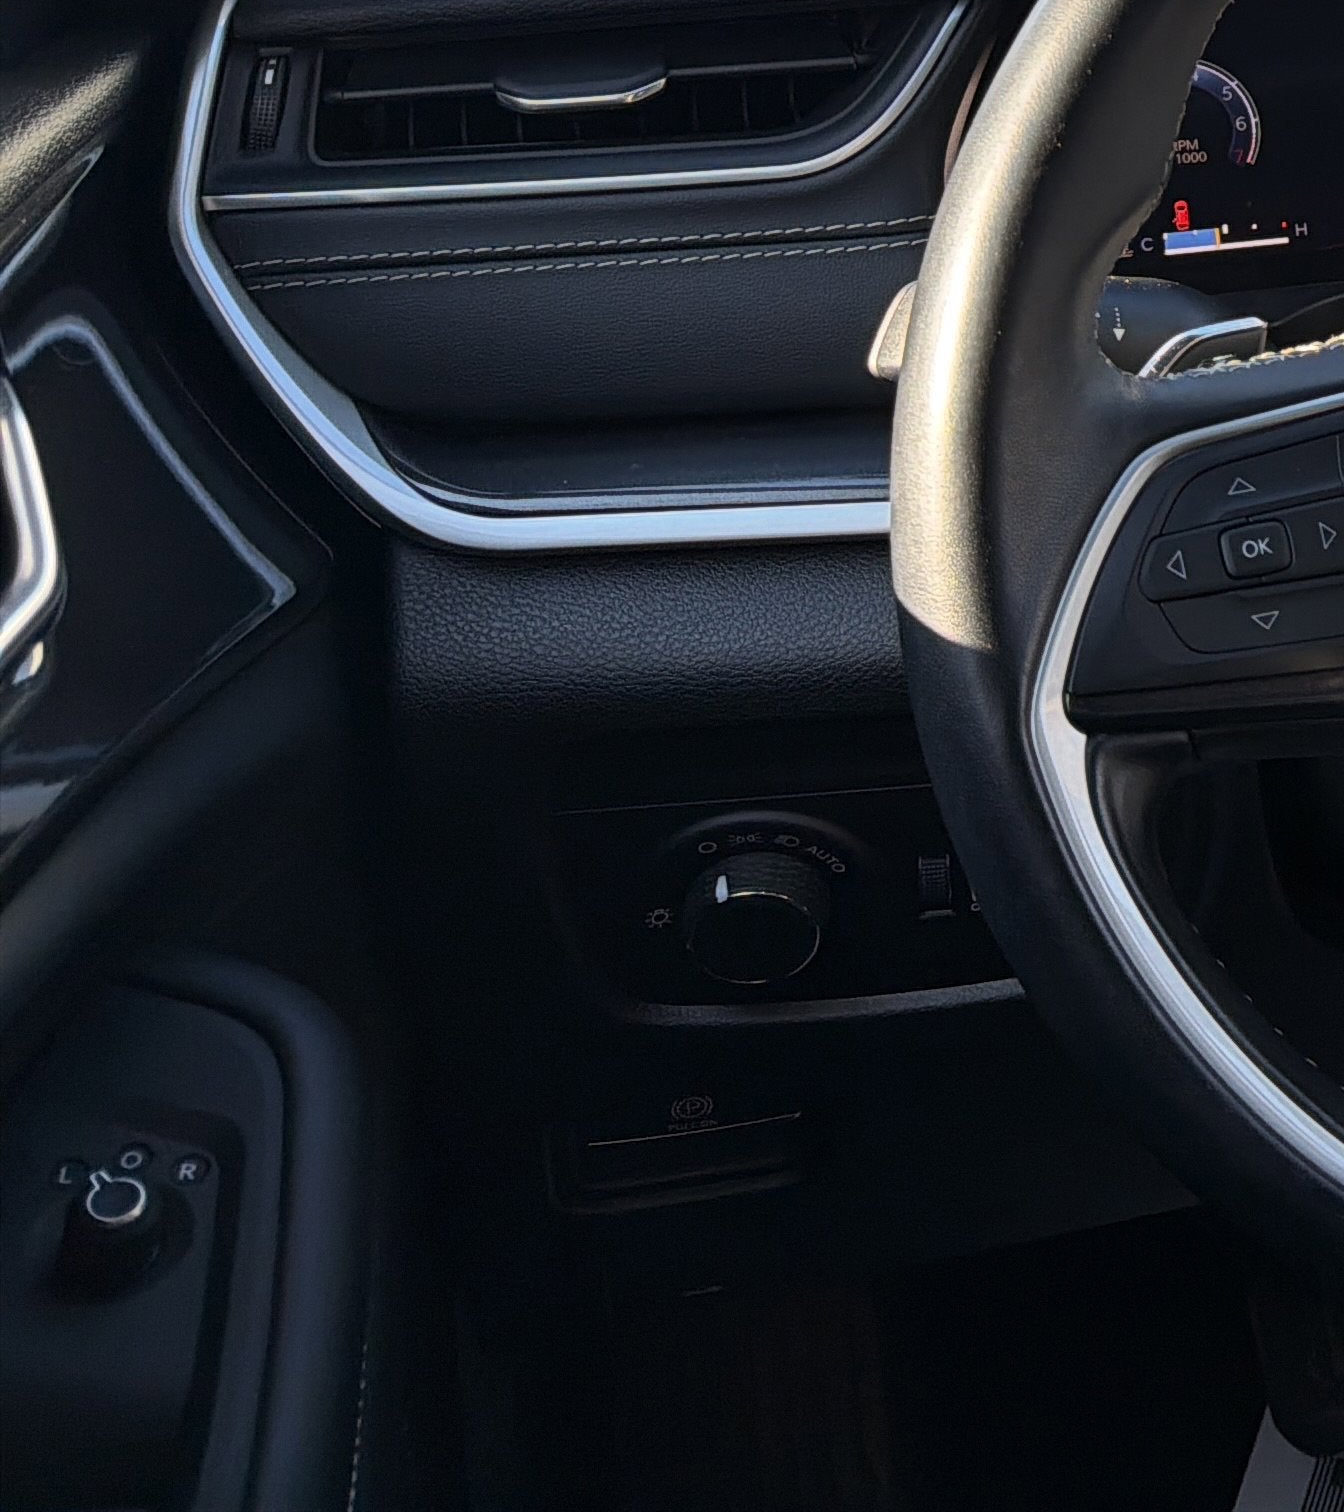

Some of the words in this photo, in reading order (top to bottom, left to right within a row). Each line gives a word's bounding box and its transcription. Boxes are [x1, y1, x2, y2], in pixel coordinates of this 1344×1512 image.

[1222, 86, 1233, 101] 5
[1235, 116, 1247, 132] 6
[1295, 222, 1308, 237] H
[1141, 237, 1154, 252] C
[1242, 538, 1274, 559] OK
[806, 843, 846, 874] AUTO
[59, 1165, 72, 1185] L
[178, 1162, 197, 1181] R
